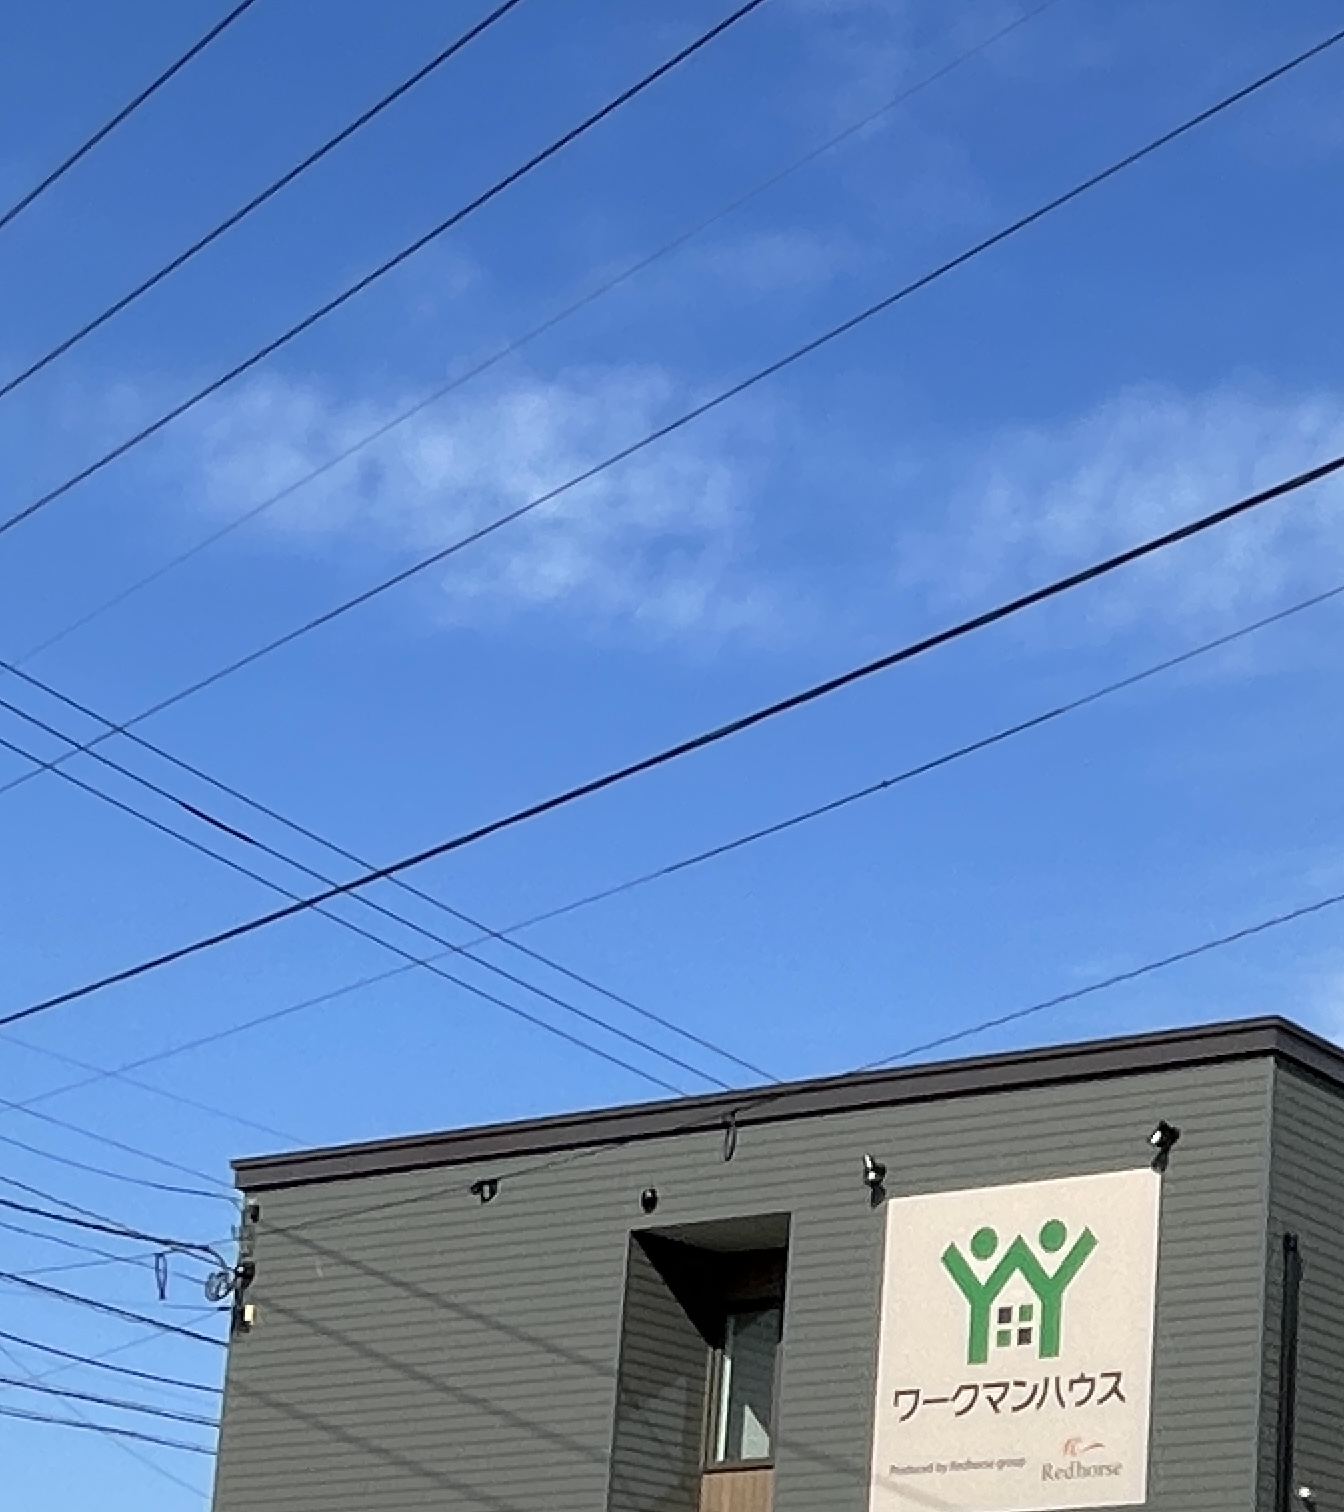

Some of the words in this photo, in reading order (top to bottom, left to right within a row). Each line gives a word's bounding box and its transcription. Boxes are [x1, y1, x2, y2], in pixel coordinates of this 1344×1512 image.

[892, 1370, 1126, 1423] ワークマンハウス
[1041, 1460, 1123, 1482] Redhorse
